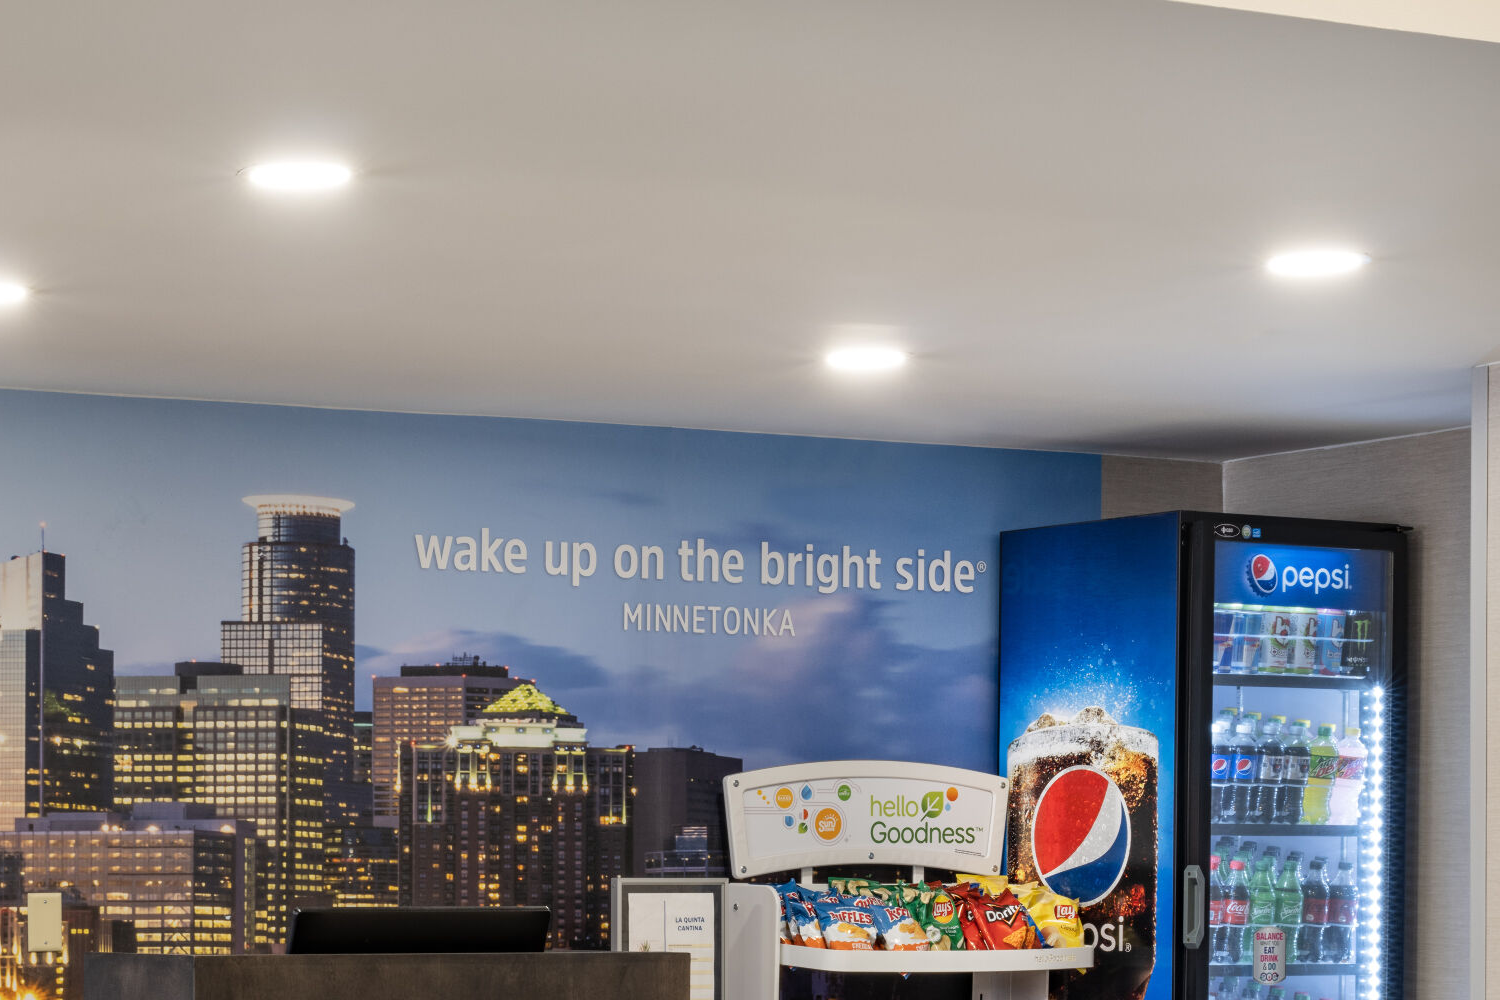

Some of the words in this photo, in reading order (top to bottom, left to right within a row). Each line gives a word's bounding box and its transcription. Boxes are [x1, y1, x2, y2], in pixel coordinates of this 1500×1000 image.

[415, 528, 527, 573] wake
[546, 541, 596, 586] up
[615, 544, 663, 579] on
[678, 539, 743, 583] the
[762, 542, 880, 593] bright
[1282, 564, 1350, 595] pepsi
[623, 602, 796, 637] MINNETONKA
[870, 794, 918, 817] hello
[829, 910, 872, 924] RUFFLES
[1256, 932, 1283, 940] BALANCE
[1260, 954, 1278, 962] DRINK
[1264, 946, 1275, 954] EAT
